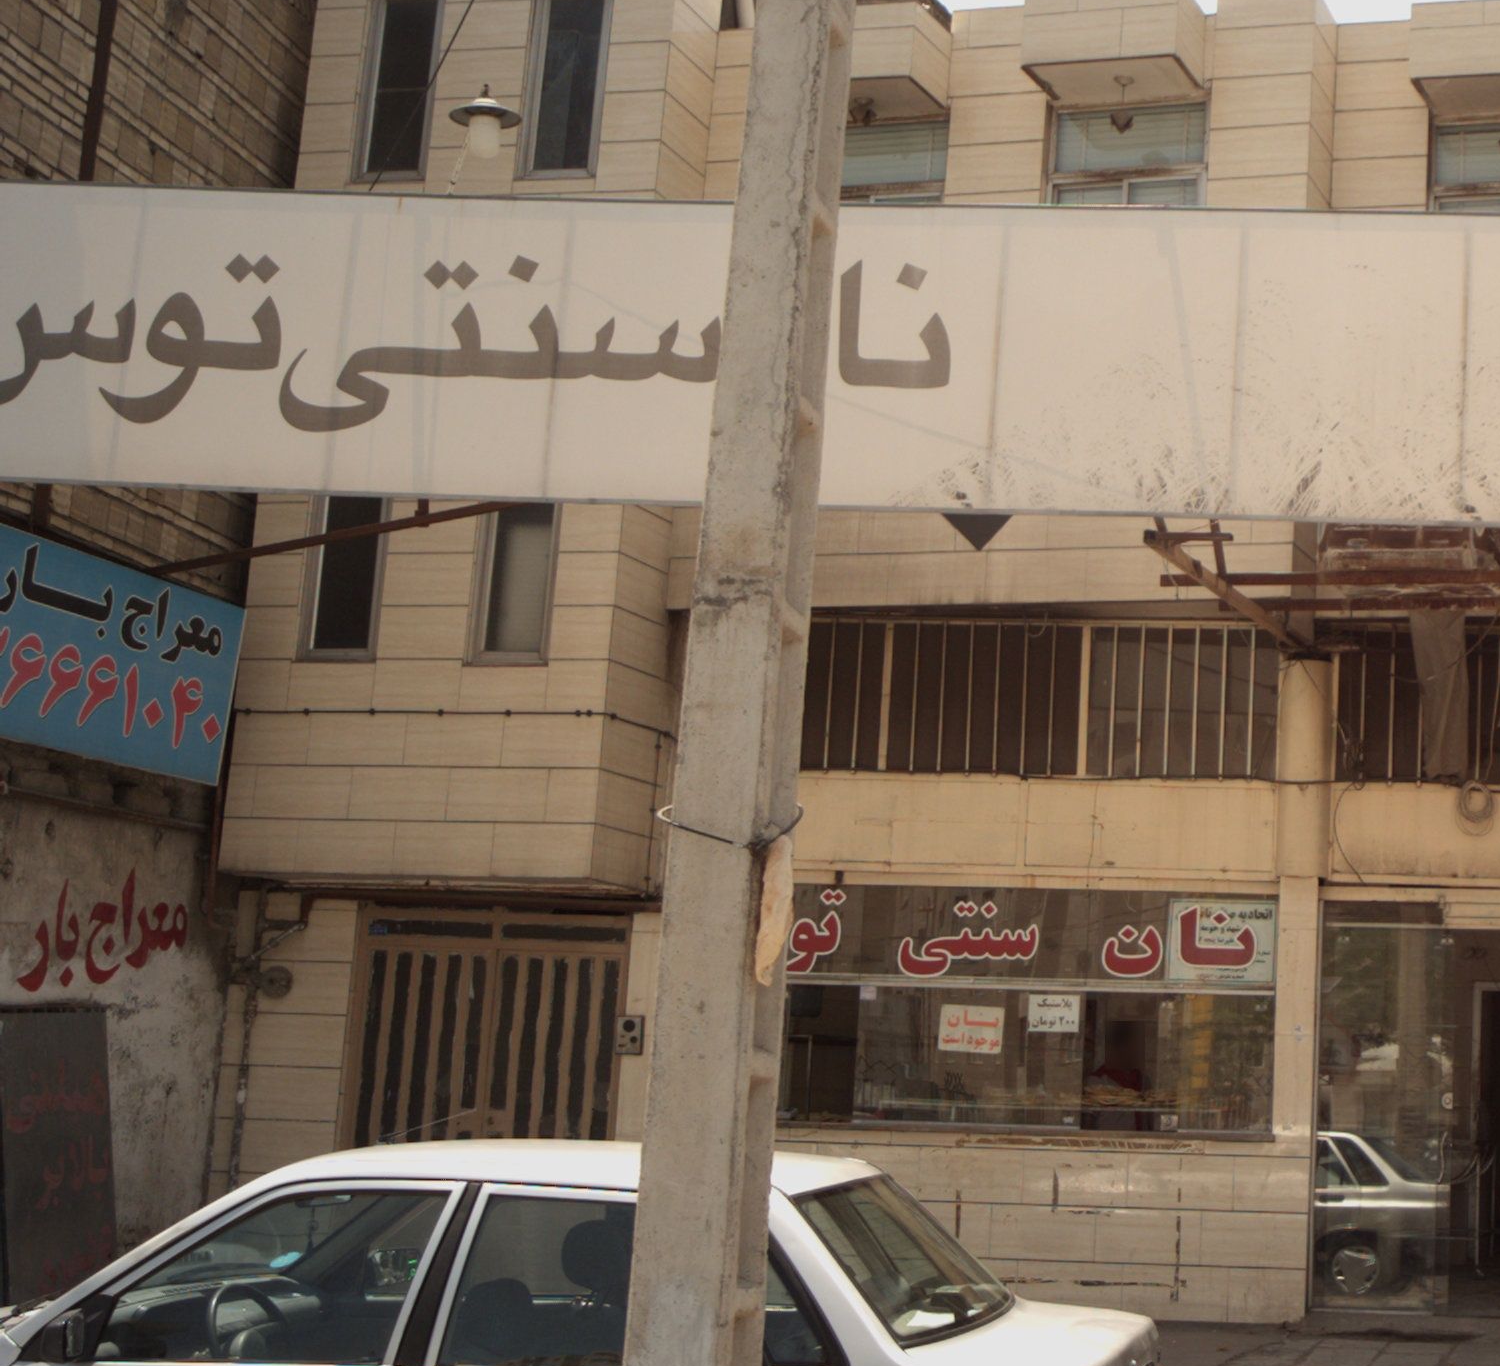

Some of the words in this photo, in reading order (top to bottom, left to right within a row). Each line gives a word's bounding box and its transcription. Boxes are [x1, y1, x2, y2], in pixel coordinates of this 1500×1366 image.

[0, 253, 281, 424] توس
[279, 254, 722, 432] سنتی
[121, 587, 222, 663] معراج
[0, 626, 221, 748] ۶۶۶۱۰۴۰
[16, 878, 79, 992] بار
[85, 866, 188, 985] معراج
[898, 900, 1040, 978] سنتی
[1101, 904, 1257, 978] نان
[947, 1009, 999, 1028] نان
[1031, 1015, 1056, 1029] تومان
